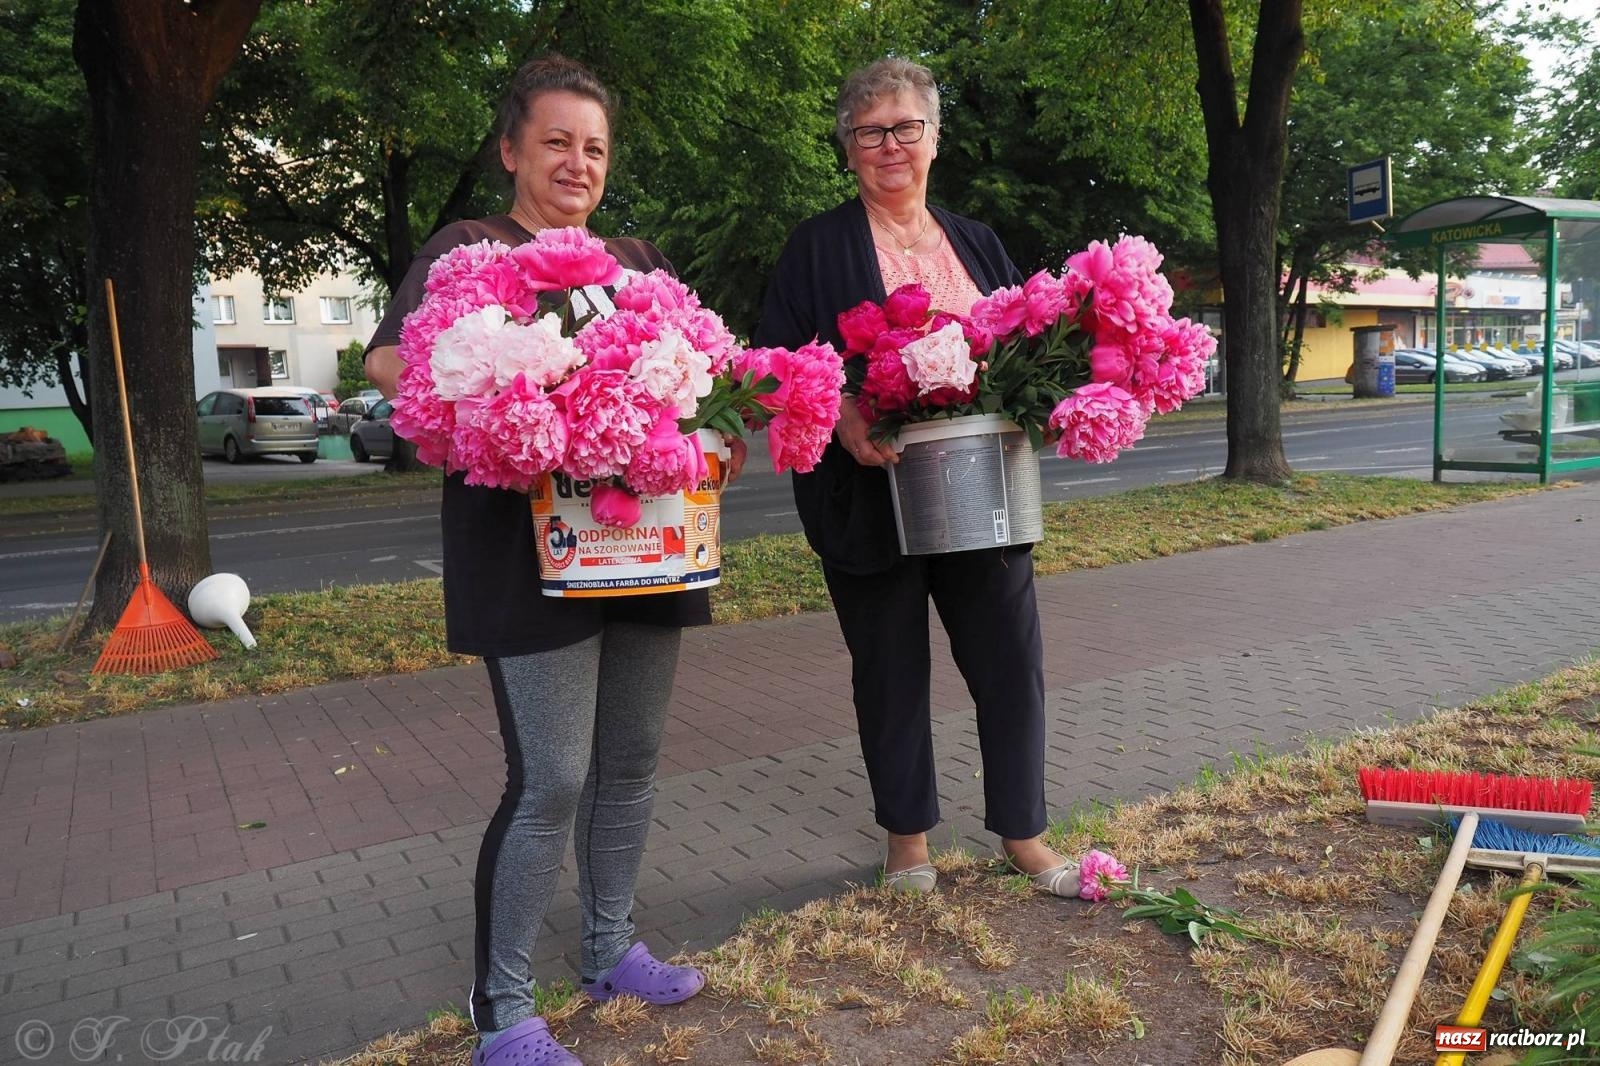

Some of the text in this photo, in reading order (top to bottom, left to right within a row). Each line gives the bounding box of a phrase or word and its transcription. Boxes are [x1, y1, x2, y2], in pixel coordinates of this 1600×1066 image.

[1431, 223, 1503, 244] KATOWICKA
[578, 526, 660, 543] ODPORNA
[578, 542, 662, 556] NA SZOROWANIE
[566, 580, 614, 589] ŚNIEŻNOBIAŁA
[615, 578, 640, 588] FARBA
[641, 577, 652, 586] DO
